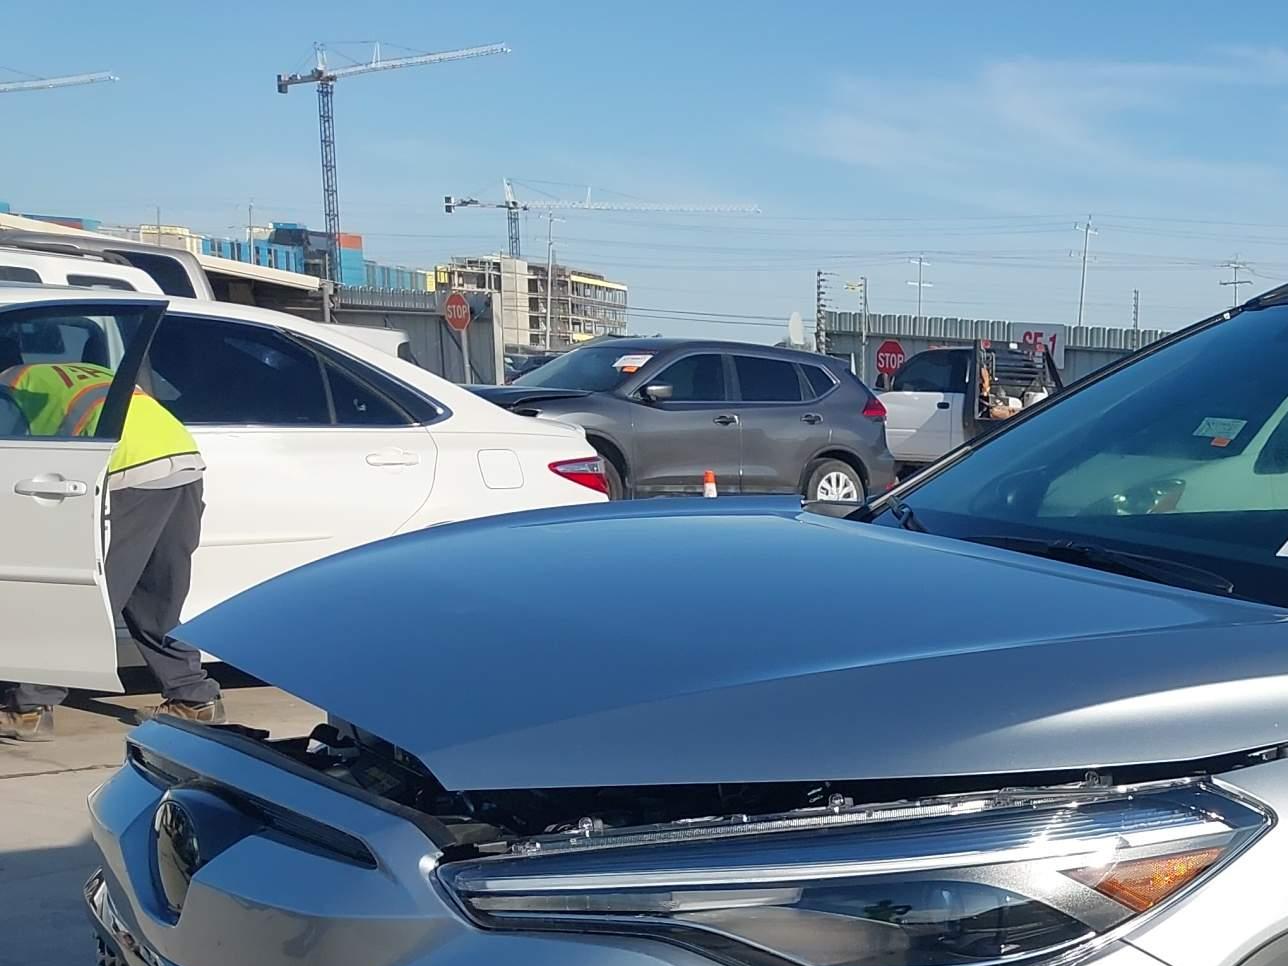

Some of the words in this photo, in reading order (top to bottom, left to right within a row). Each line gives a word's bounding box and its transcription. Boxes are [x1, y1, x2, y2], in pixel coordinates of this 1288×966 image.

[447, 304, 468, 319] STOP
[1023, 331, 1057, 359] SF1
[878, 352, 904, 369] STOP
